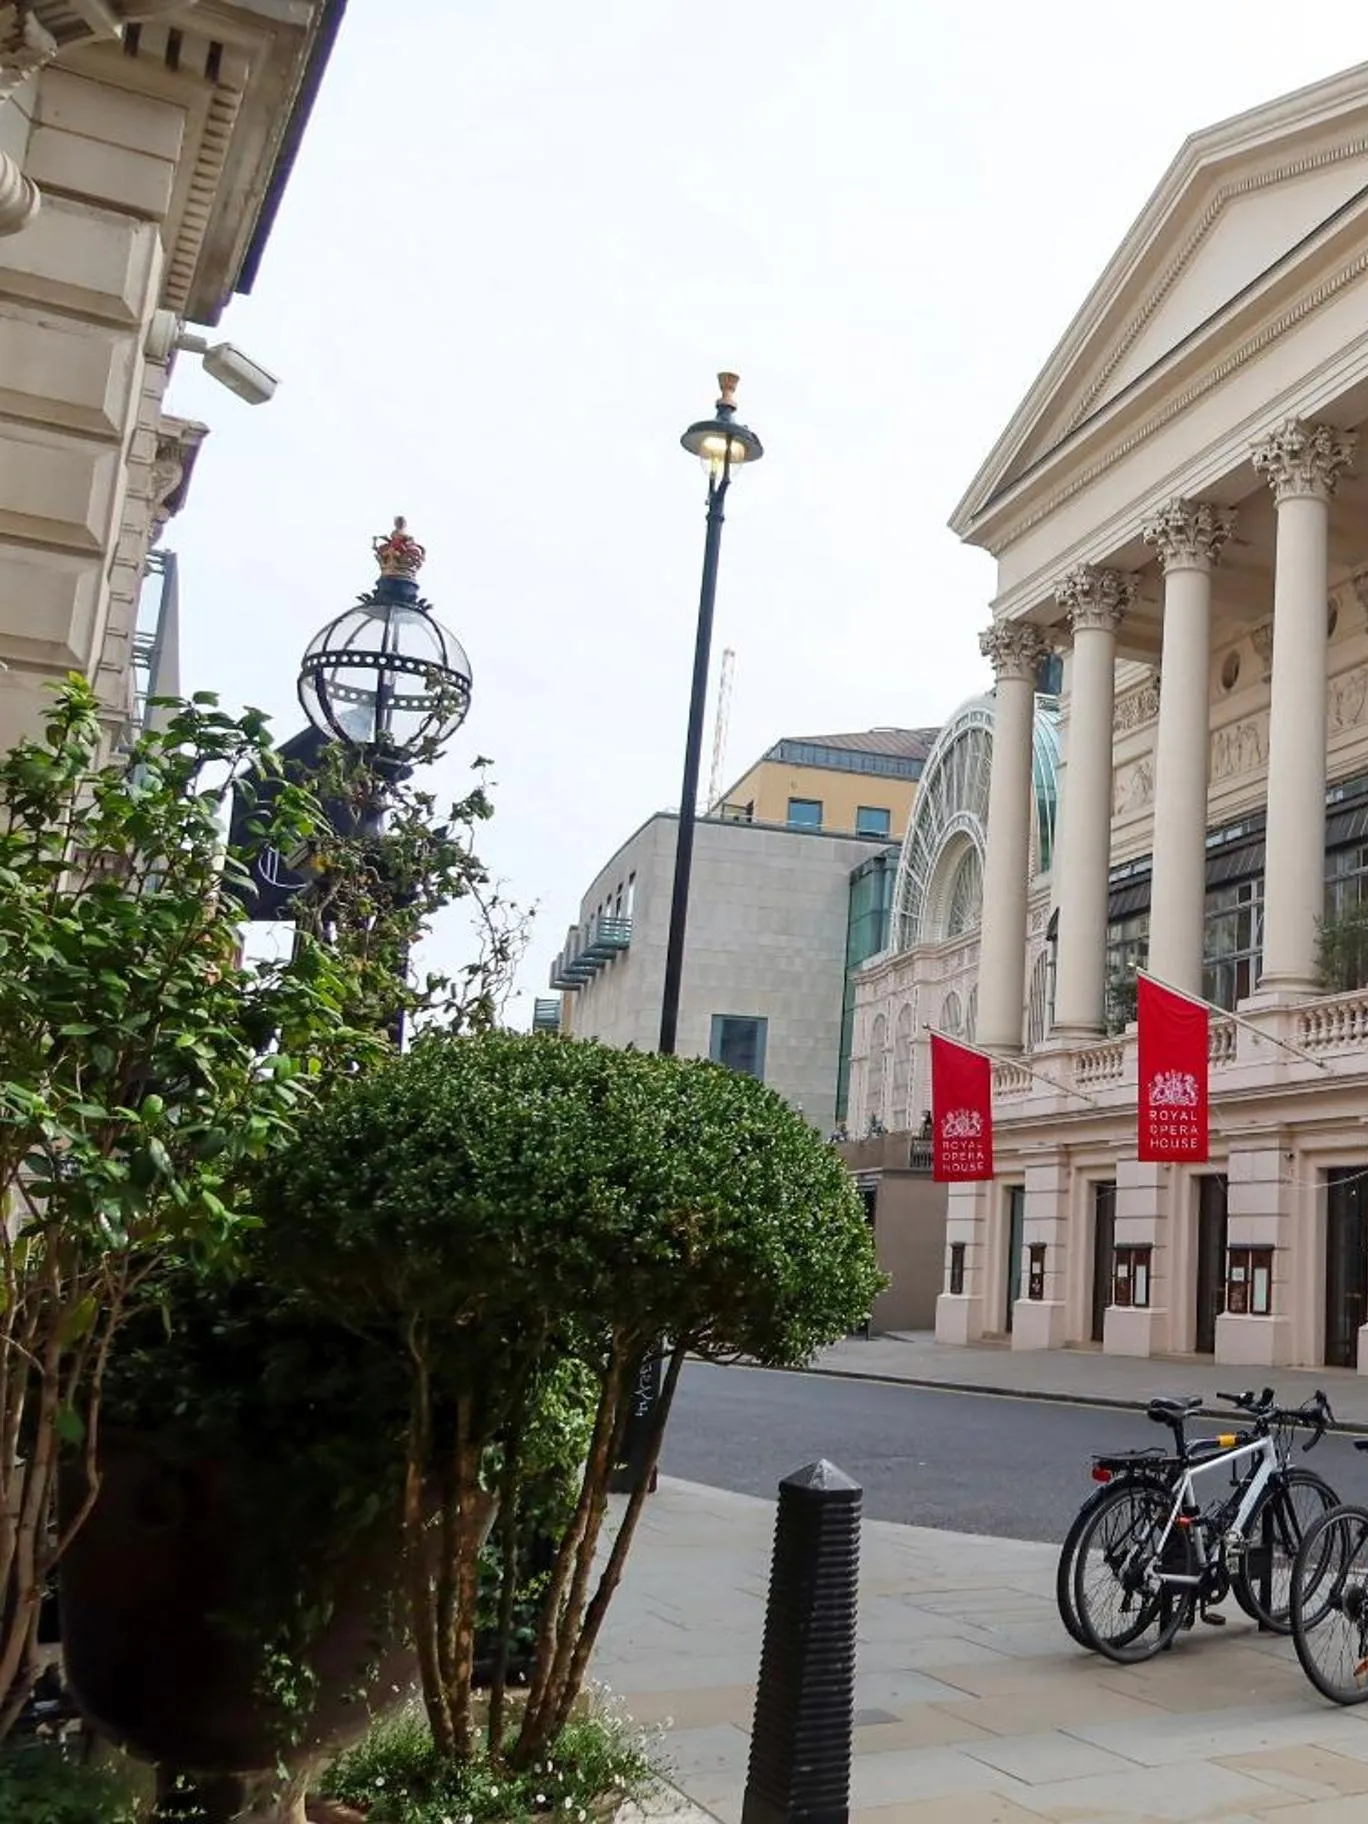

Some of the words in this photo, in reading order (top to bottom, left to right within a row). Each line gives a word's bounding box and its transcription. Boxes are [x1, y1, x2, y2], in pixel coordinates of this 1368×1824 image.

[1149, 1110, 1197, 1121] ROYAL
[1149, 1124, 1199, 1136] OPERA
[1150, 1137, 1199, 1149] HOUSE
[942, 1151, 984, 1161] OPERA
[942, 1161, 984, 1172] HOUSE
